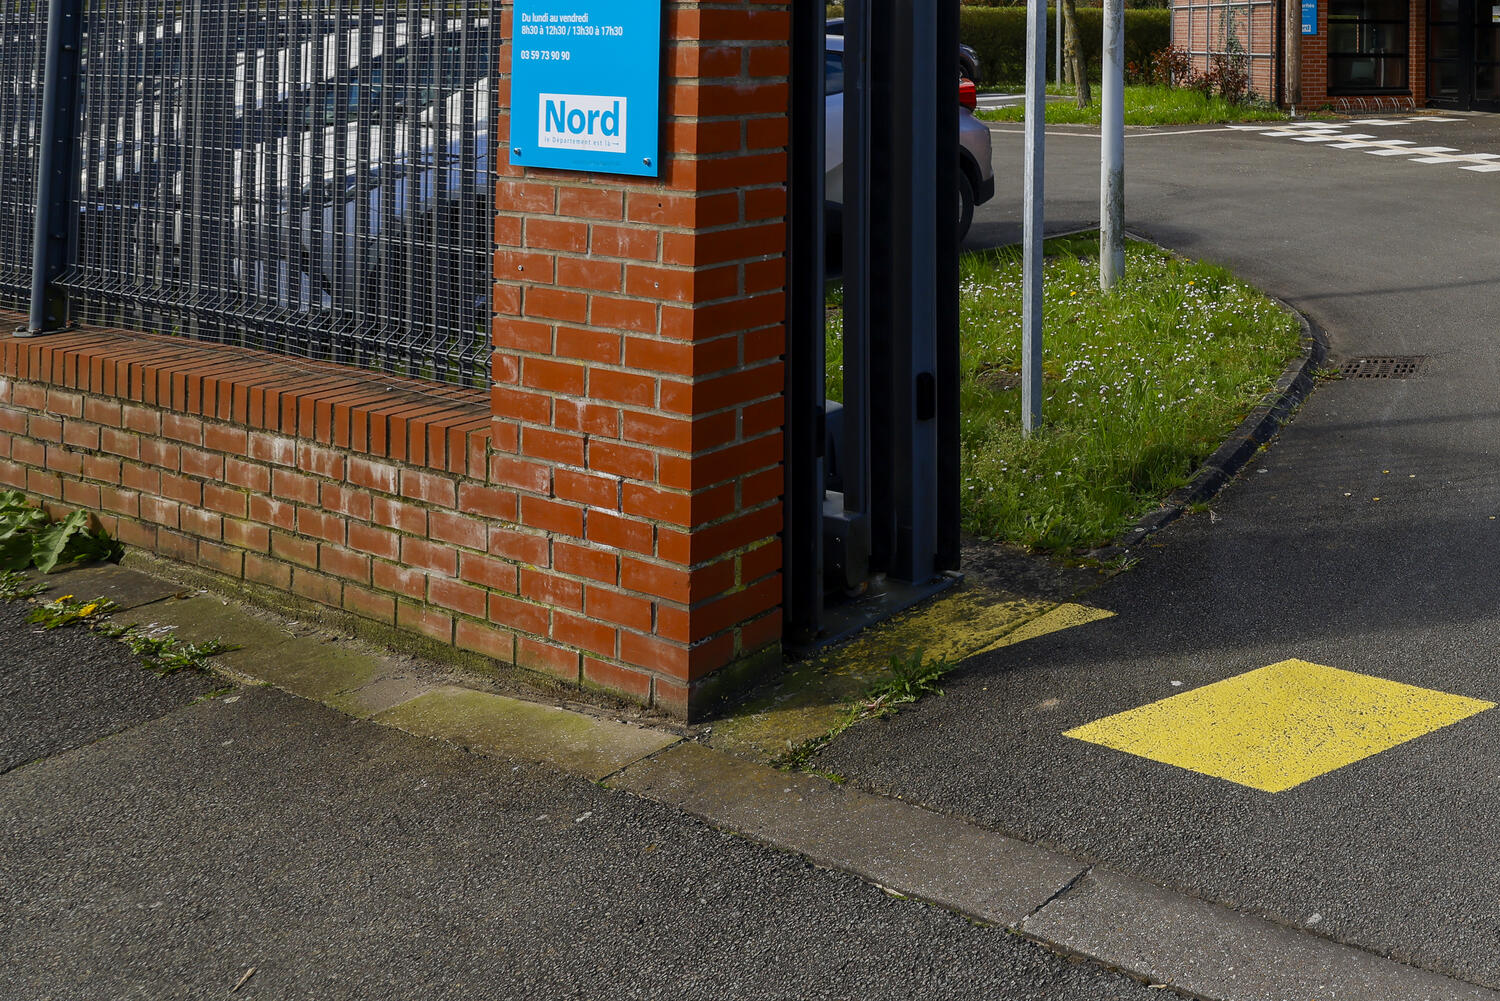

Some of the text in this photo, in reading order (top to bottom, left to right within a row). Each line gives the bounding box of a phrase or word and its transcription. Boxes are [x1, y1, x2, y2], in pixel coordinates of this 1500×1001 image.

[521, 12, 589, 22] Du lundi au vendredi
[521, 25, 623, 36] 8h30 à 12h30 / 13h30 à 17h30
[520, 50, 570, 60] 03 59 73 90 90
[545, 99, 619, 137] Nord
